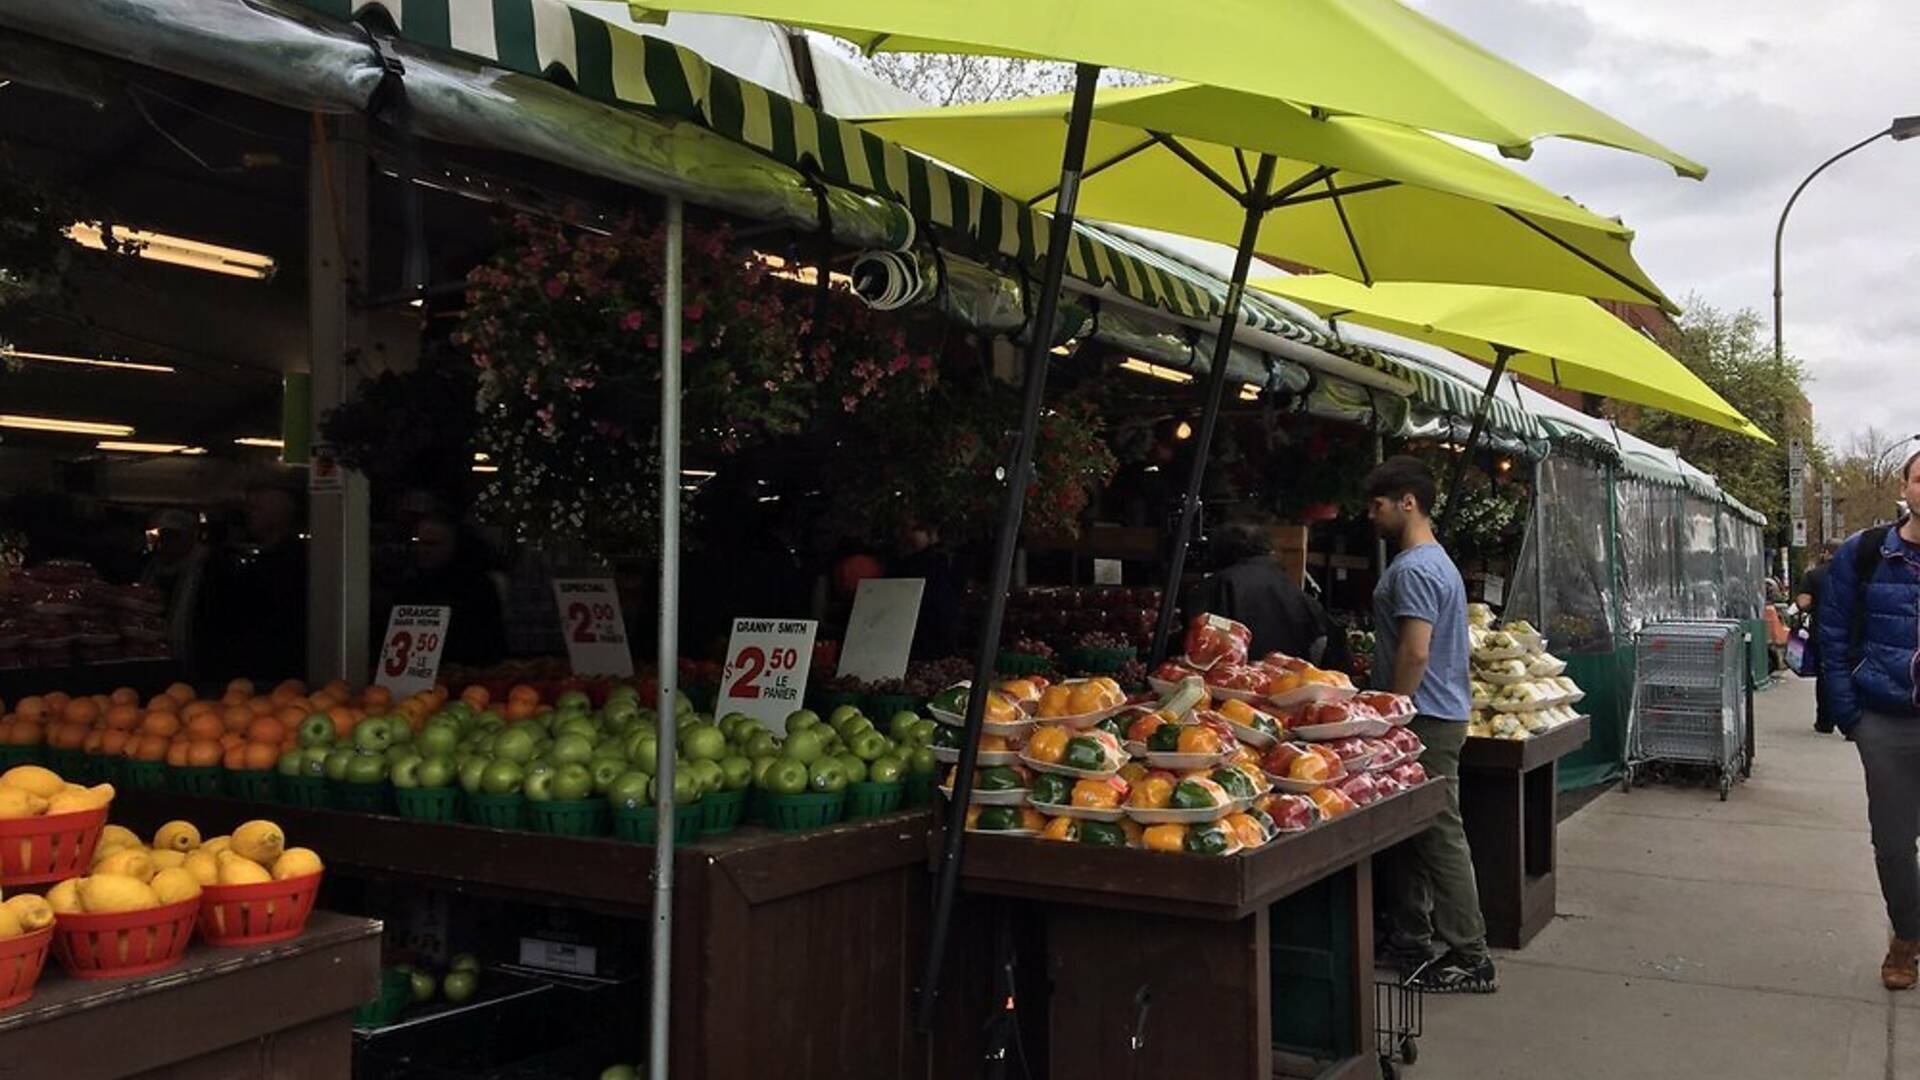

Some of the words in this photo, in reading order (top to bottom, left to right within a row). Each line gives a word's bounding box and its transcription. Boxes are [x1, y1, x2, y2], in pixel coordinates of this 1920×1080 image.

[399, 607, 442, 618] ORANGE
[737, 621, 775, 633] GRANNY
[778, 622, 807, 634] SMITH
[776, 676, 788, 687] LE
[763, 687, 798, 700] PANIER
